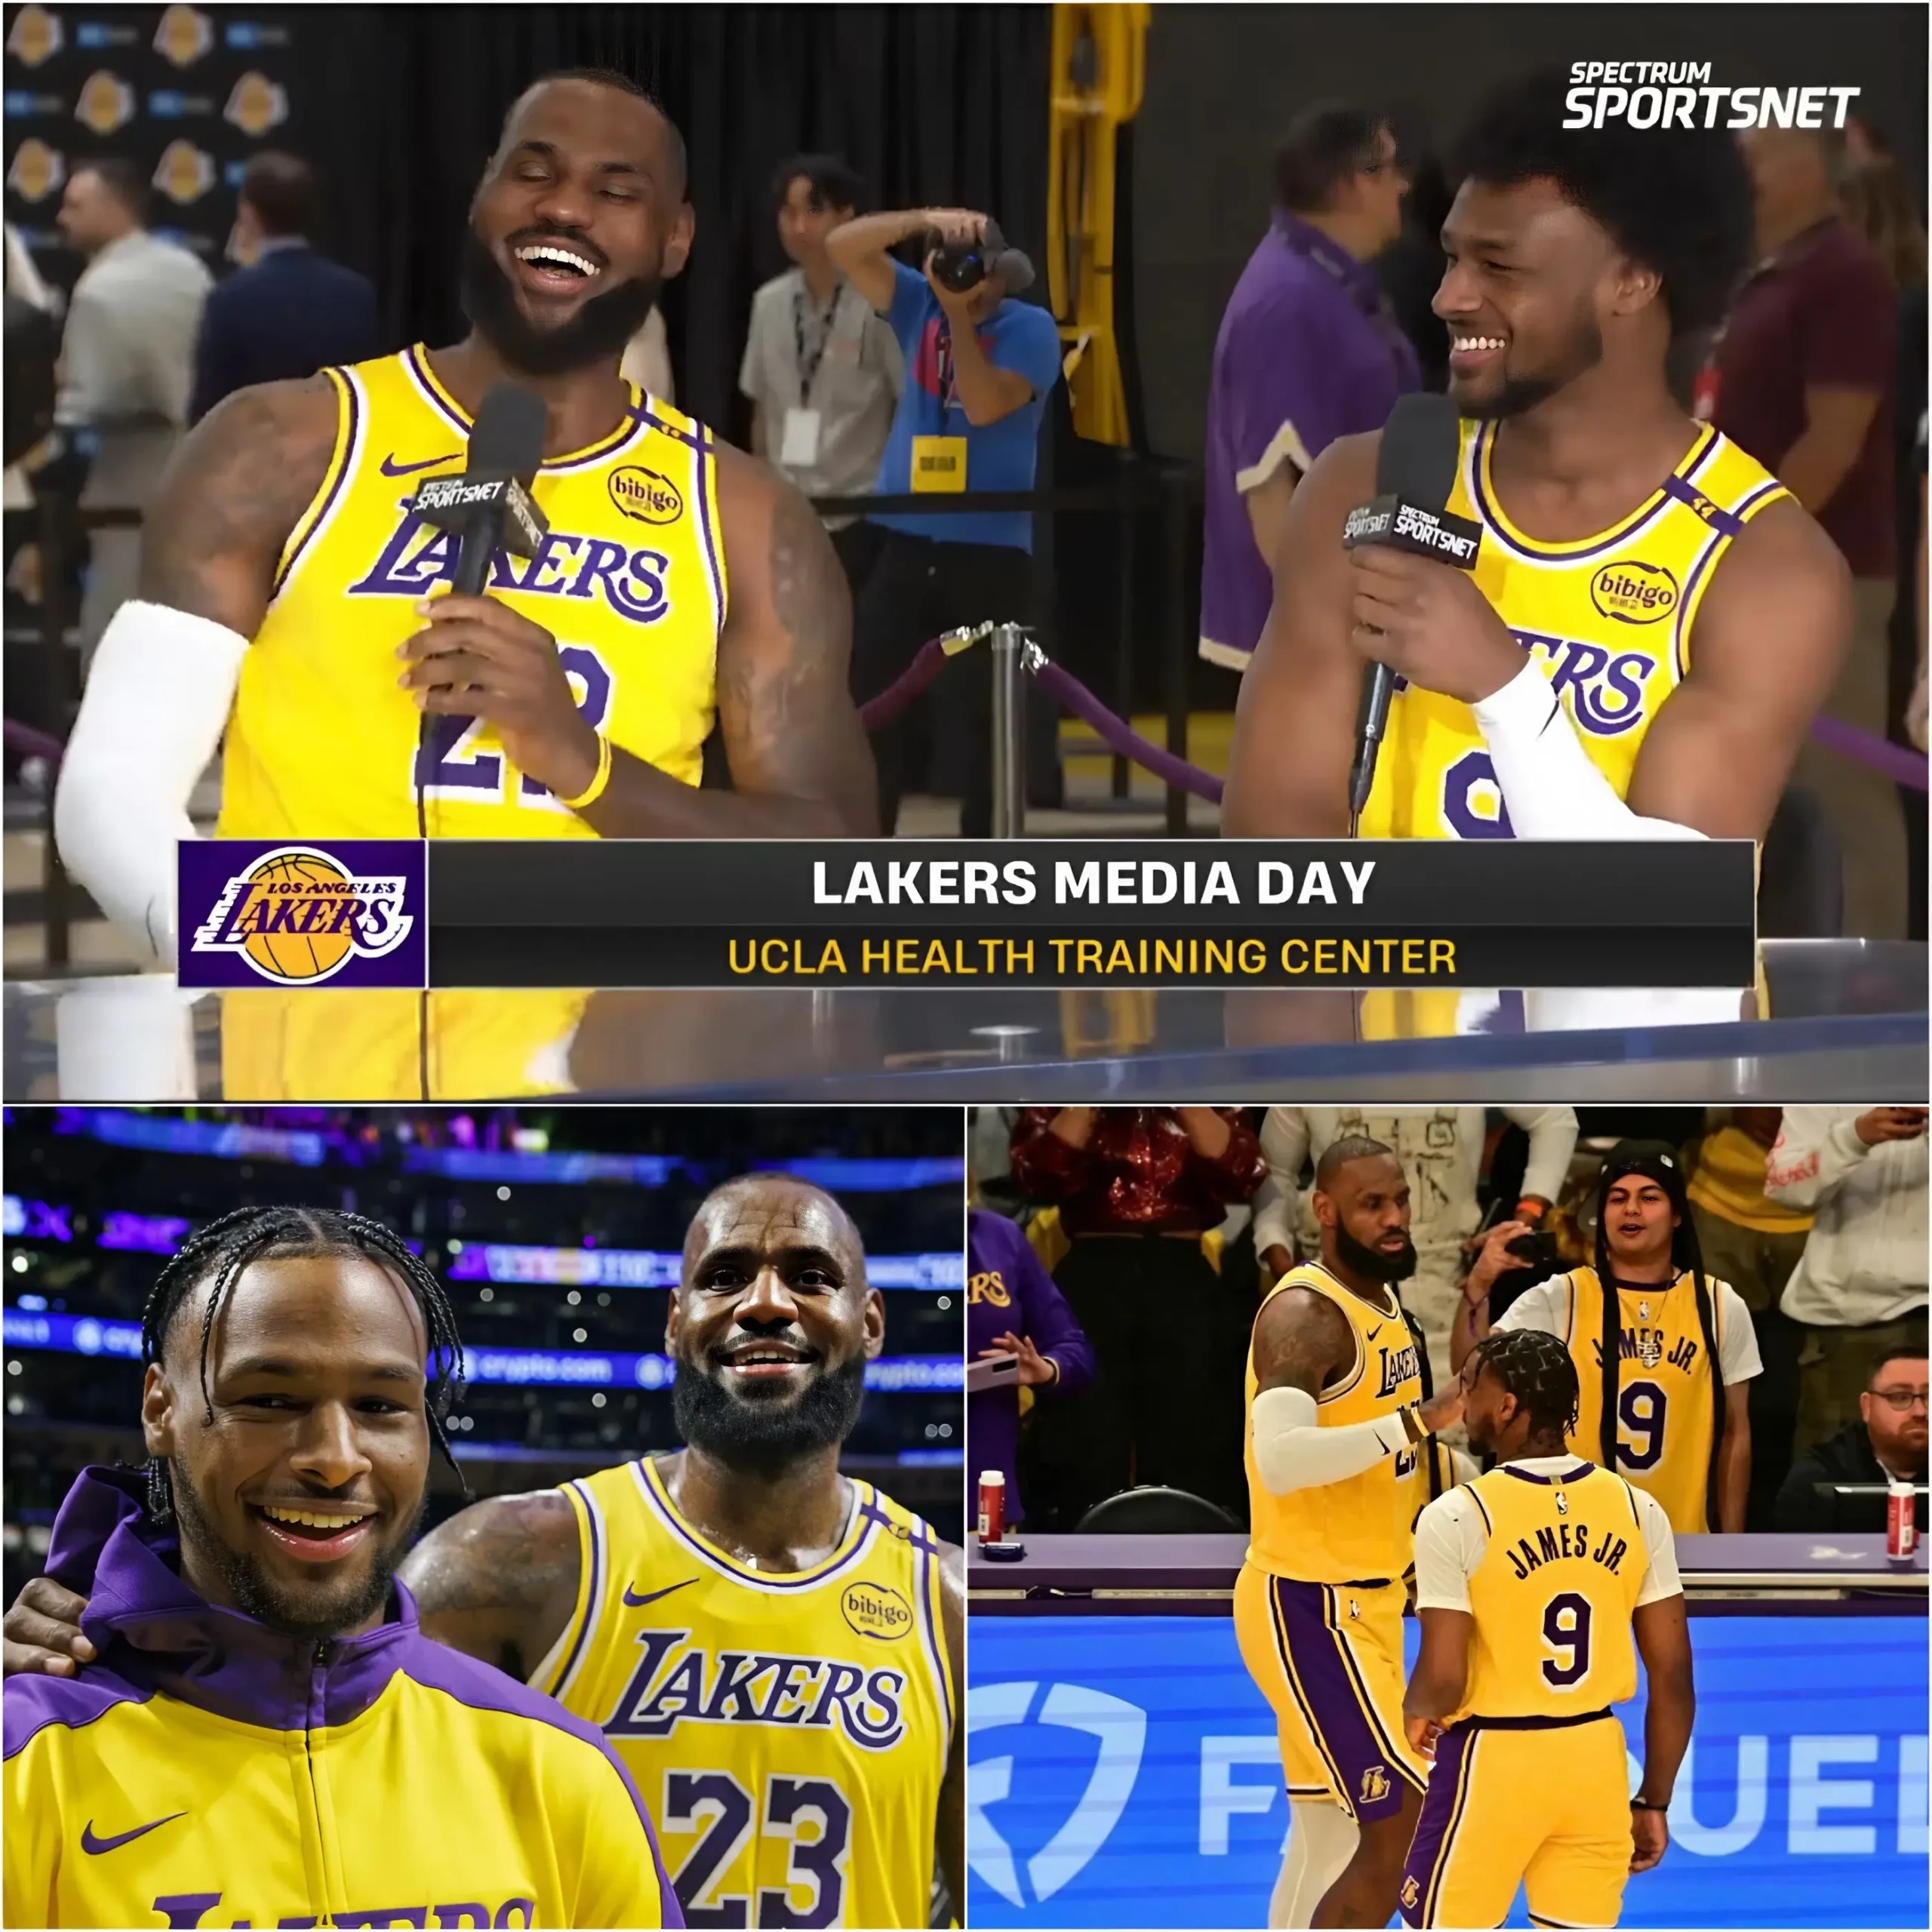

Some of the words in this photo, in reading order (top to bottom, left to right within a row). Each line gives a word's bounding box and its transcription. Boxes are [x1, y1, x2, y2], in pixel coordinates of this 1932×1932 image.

[615, 475, 678, 512] bibigo
[1393, 516, 1478, 560] SPORTSNET
[1598, 573, 1673, 609] bibigo
[1666, 1336, 1698, 1376] JR.
[1616, 1380, 1668, 1471] 9
[1506, 1523, 1588, 1580] JAMES
[1592, 1531, 1628, 1577] JR.
[848, 1592, 909, 1626] bibigo
[1542, 1592, 1592, 1687] 9
[603, 1632, 904, 1749] LAKERS
[667, 1774, 851, 1929] 23
